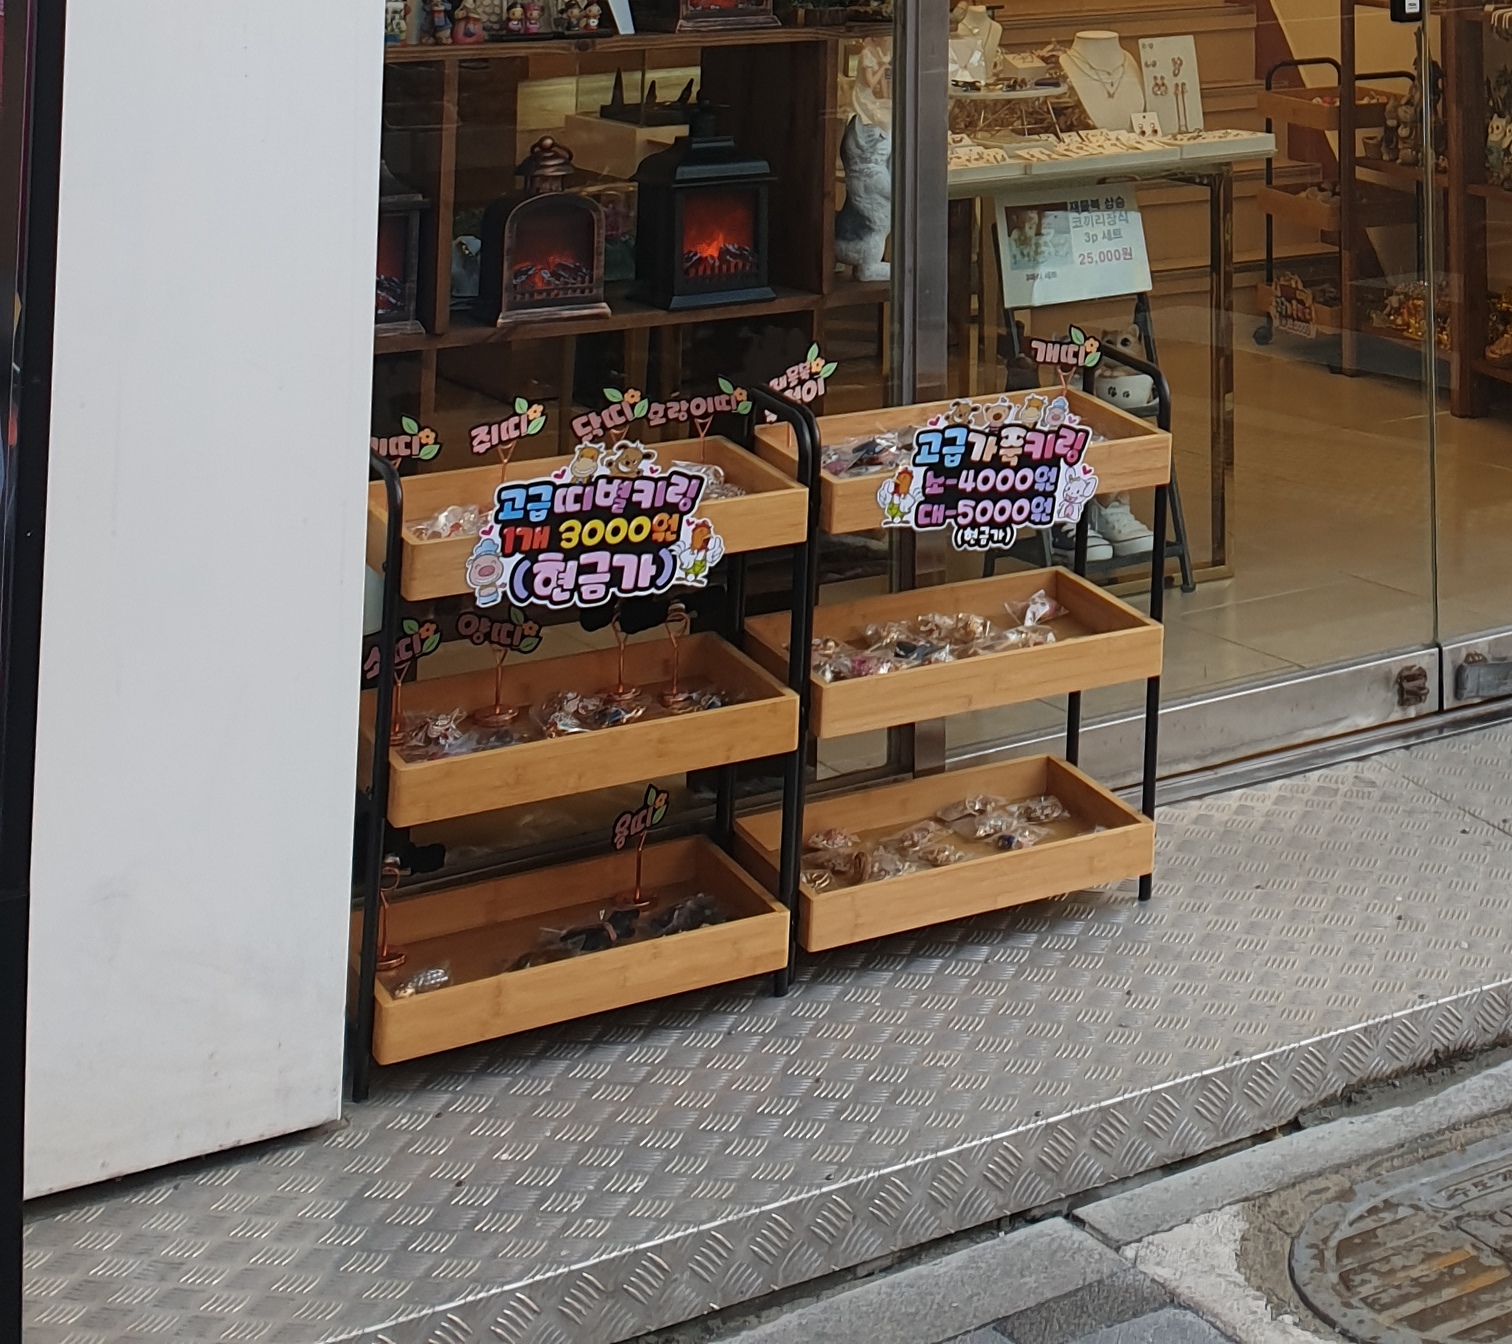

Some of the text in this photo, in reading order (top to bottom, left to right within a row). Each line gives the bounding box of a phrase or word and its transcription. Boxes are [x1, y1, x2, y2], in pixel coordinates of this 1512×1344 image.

[1078, 247, 1133, 265] 25,000원
[1031, 340, 1086, 365] 개띠
[647, 394, 737, 426] 호랑이띠
[470, 414, 528, 453] 쥐띠
[915, 425, 1087, 466] 고급가족키링
[497, 474, 700, 520] 고급띠별키링
[917, 497, 1054, 525] 대-5000원
[502, 513, 680, 554] 1개 3000원
[956, 525, 1011, 547] (현금가)
[509, 548, 676, 599] (현금가)
[458, 614, 522, 646] 양띠
